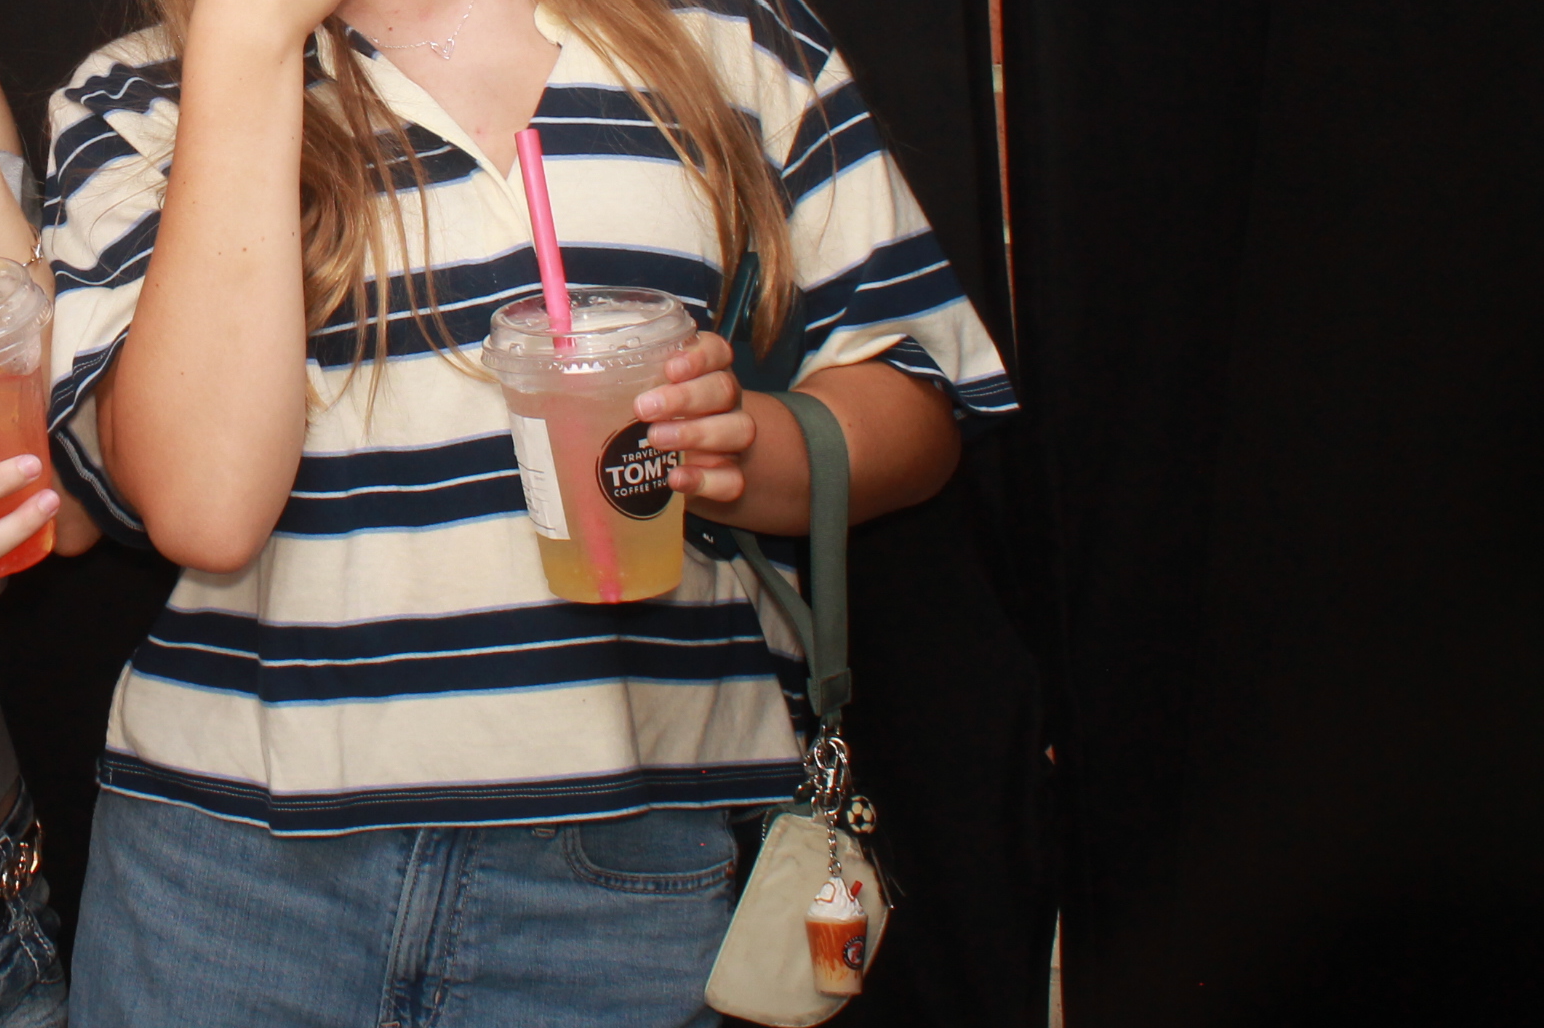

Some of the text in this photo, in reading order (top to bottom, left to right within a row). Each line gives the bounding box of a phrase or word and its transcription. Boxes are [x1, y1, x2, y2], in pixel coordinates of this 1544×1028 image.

[621, 448, 664, 463] TRAVEL
[605, 451, 678, 487] TOM'S
[614, 477, 669, 497] COFFEE TRU
